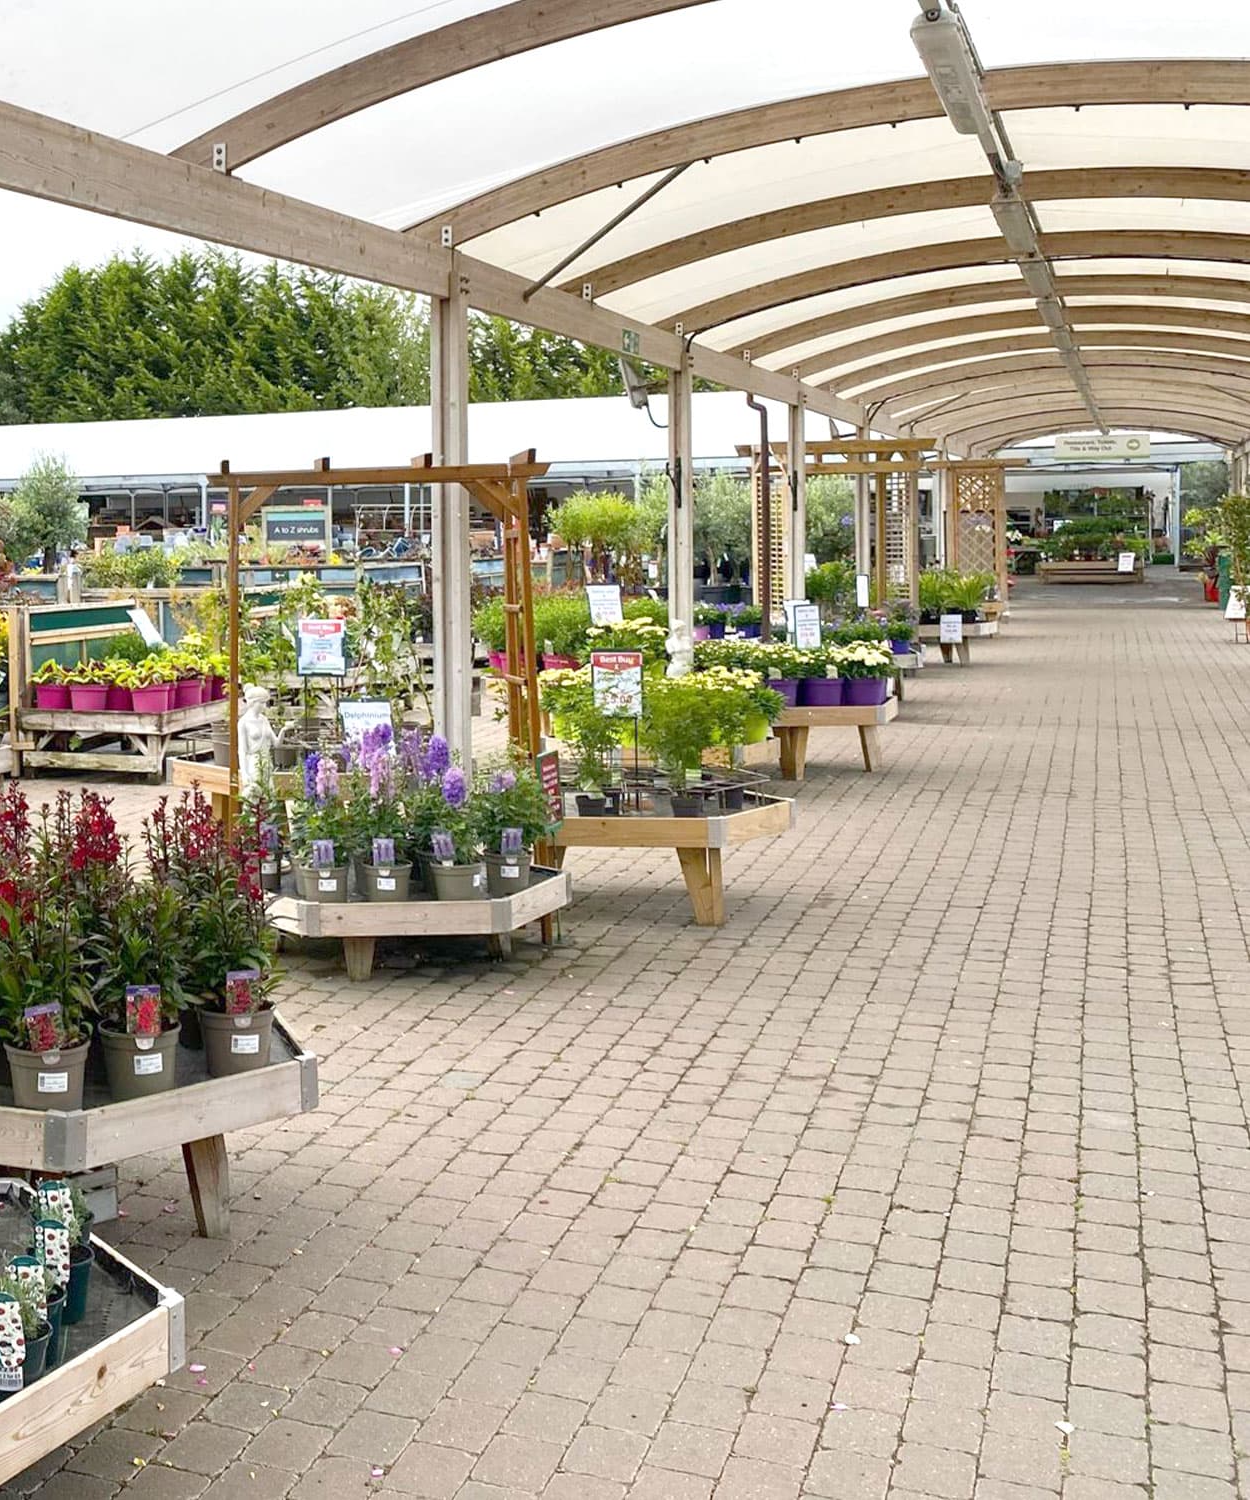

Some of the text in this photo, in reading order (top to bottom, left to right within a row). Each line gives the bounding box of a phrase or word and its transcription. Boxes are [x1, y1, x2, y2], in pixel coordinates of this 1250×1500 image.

[274, 526, 319, 534] A to Z shrubs
[617, 656, 634, 665] Buy
[344, 711, 390, 719] Delphinium
